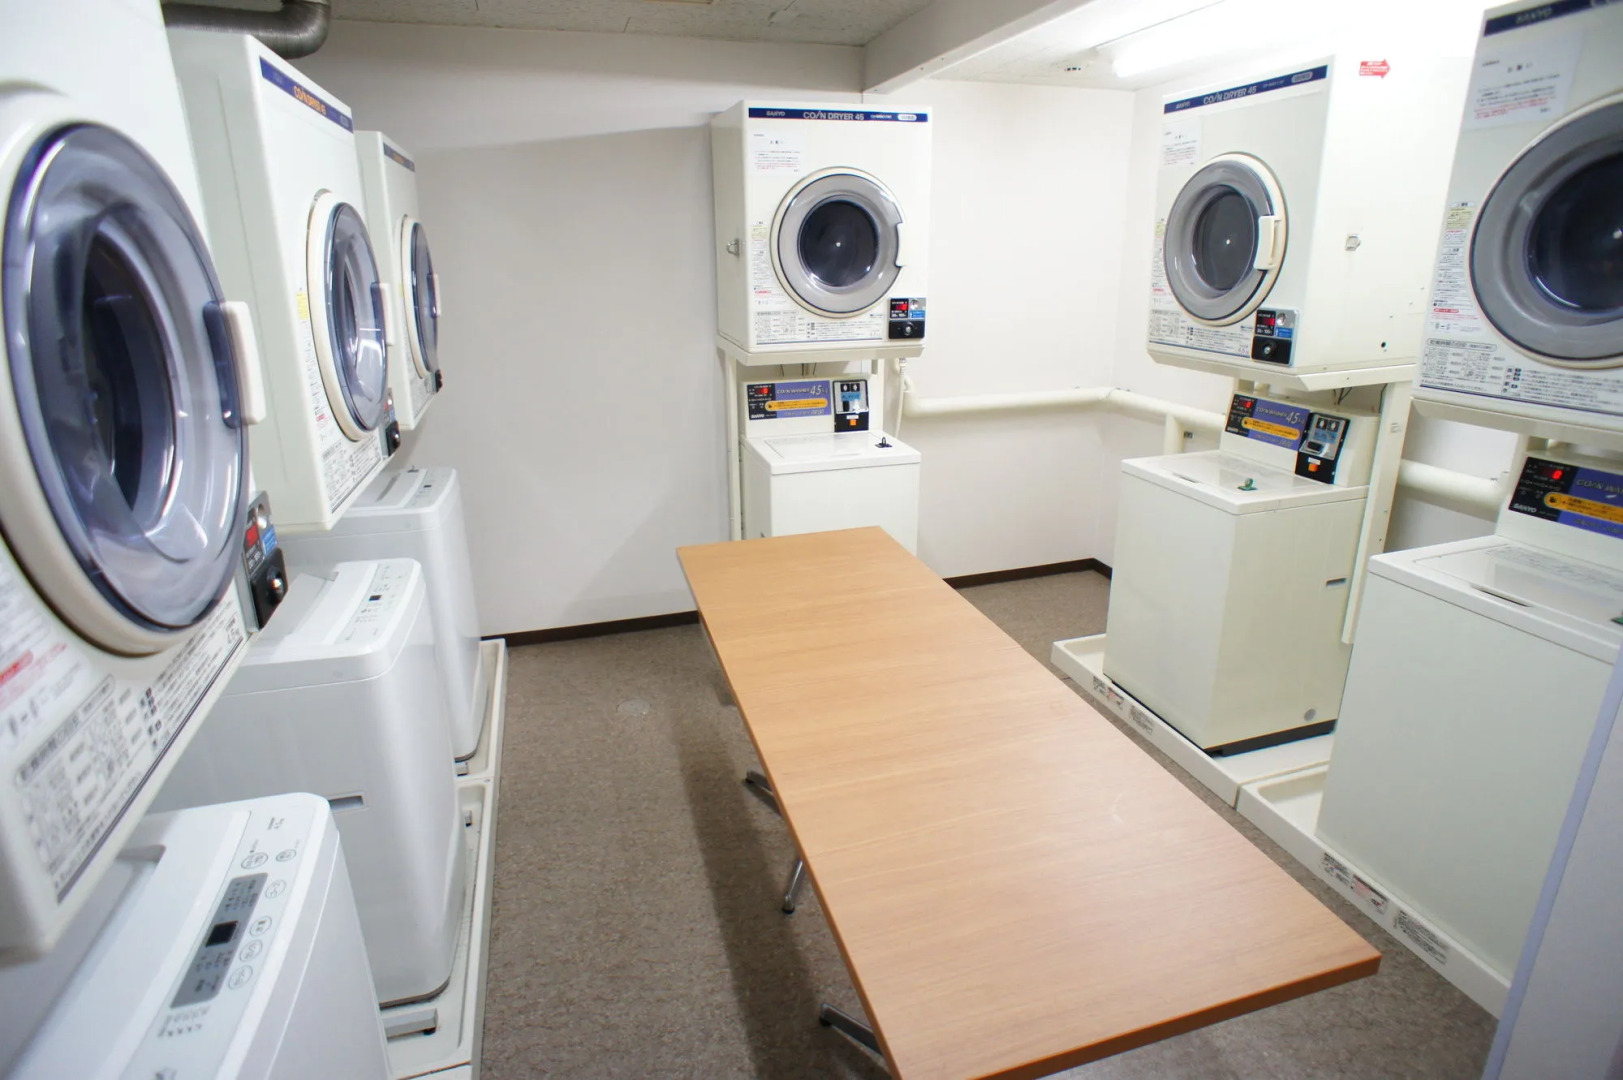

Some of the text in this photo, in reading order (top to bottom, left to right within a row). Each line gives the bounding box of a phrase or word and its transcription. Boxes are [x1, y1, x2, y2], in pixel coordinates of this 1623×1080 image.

[1223, 87, 1247, 101] DRYER
[1247, 85, 1257, 96] 45
[828, 112, 853, 121] DRYER
[1286, 411, 1300, 425] 45
[1552, 469, 1563, 480] 0
[1513, 503, 1537, 513] SANYO
